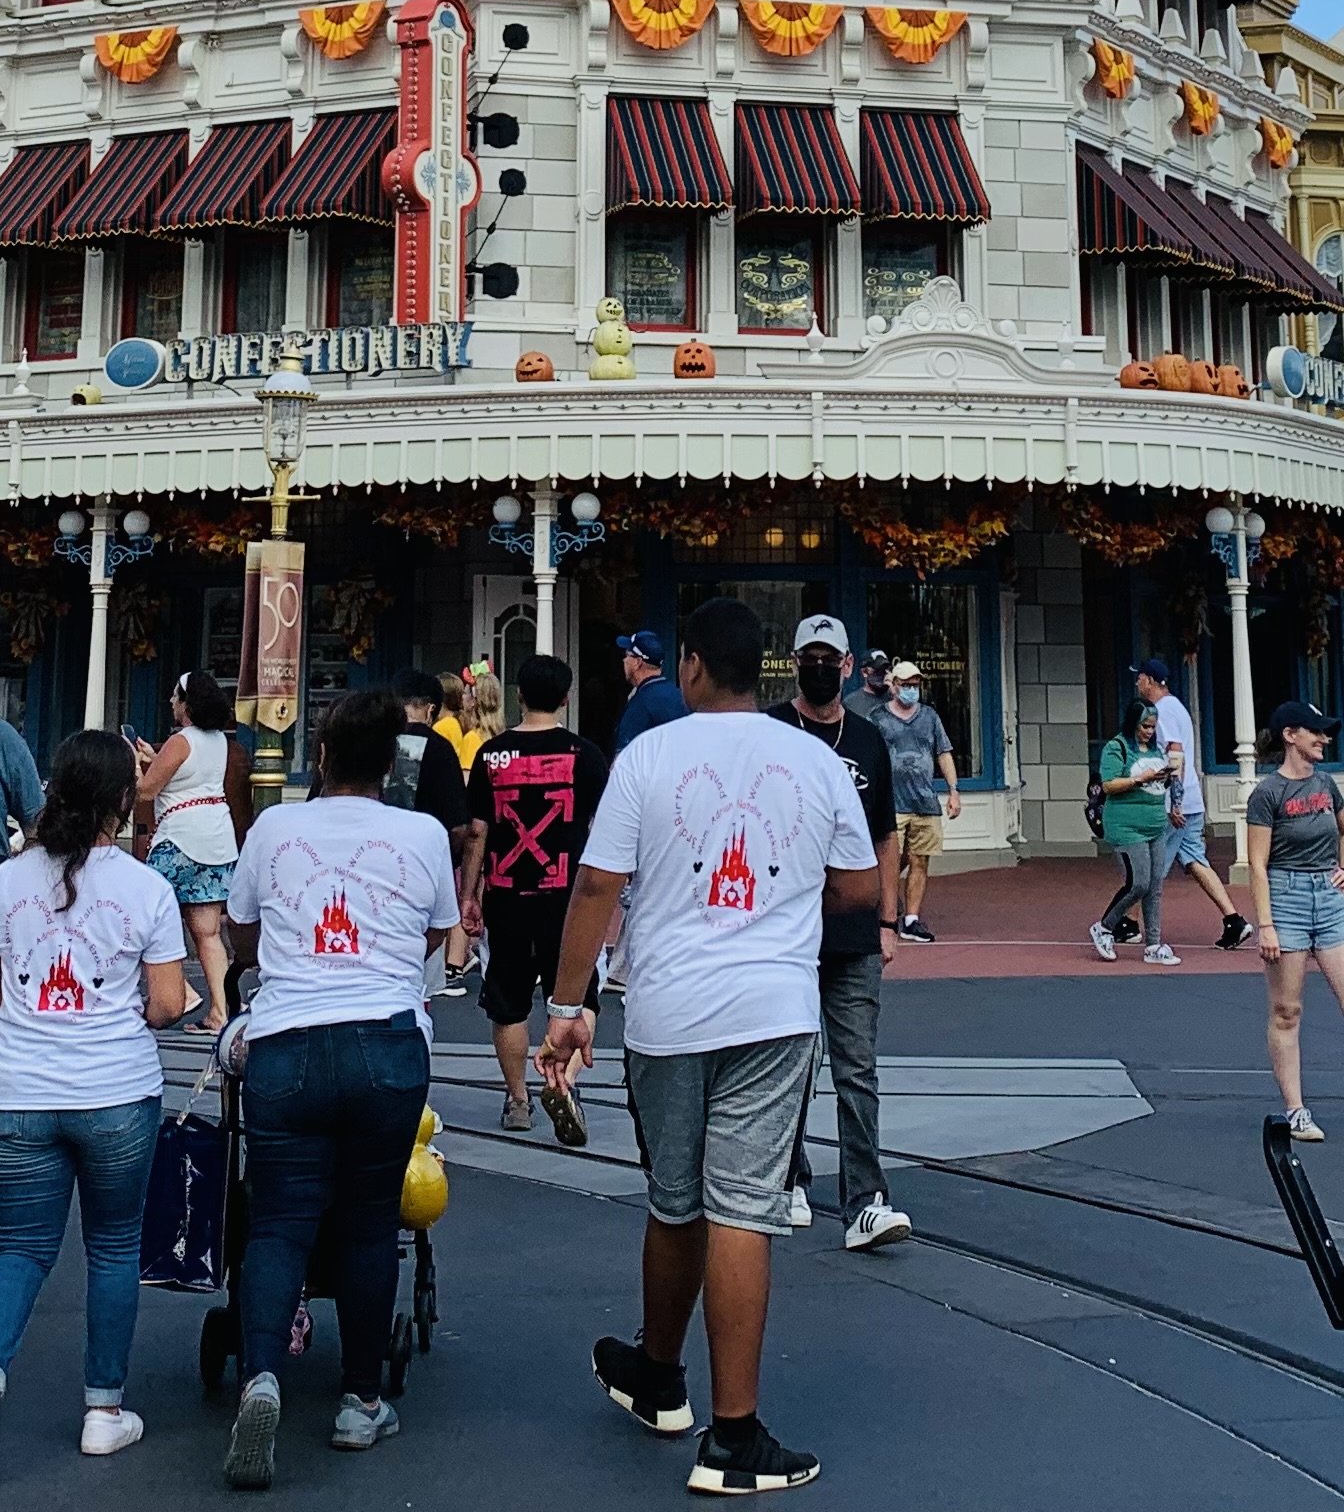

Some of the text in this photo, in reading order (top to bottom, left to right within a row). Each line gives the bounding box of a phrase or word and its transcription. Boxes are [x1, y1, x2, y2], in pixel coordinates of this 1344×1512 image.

[438, 32, 454, 323] CONFECTIONER
[163, 321, 475, 386] CONFECTIONERY
[262, 575, 300, 652] 50
[674, 765, 699, 827] Birthday
[701, 762, 728, 800] Squad
[710, 801, 734, 826] Adrian
[736, 799, 763, 821] Natalie
[747, 772, 765, 800] Walt
[766, 764, 794, 782] Disney
[794, 782, 806, 825] World
[269, 839, 292, 891] Birthday
[294, 836, 323, 867] Squad
[334, 866, 363, 884] Natalie
[347, 845, 366, 869] Walt
[367, 840, 397, 855] Disney
[31, 894, 56, 926] Squad
[75, 905, 95, 929] Walt
[96, 899, 124, 915] Disney
